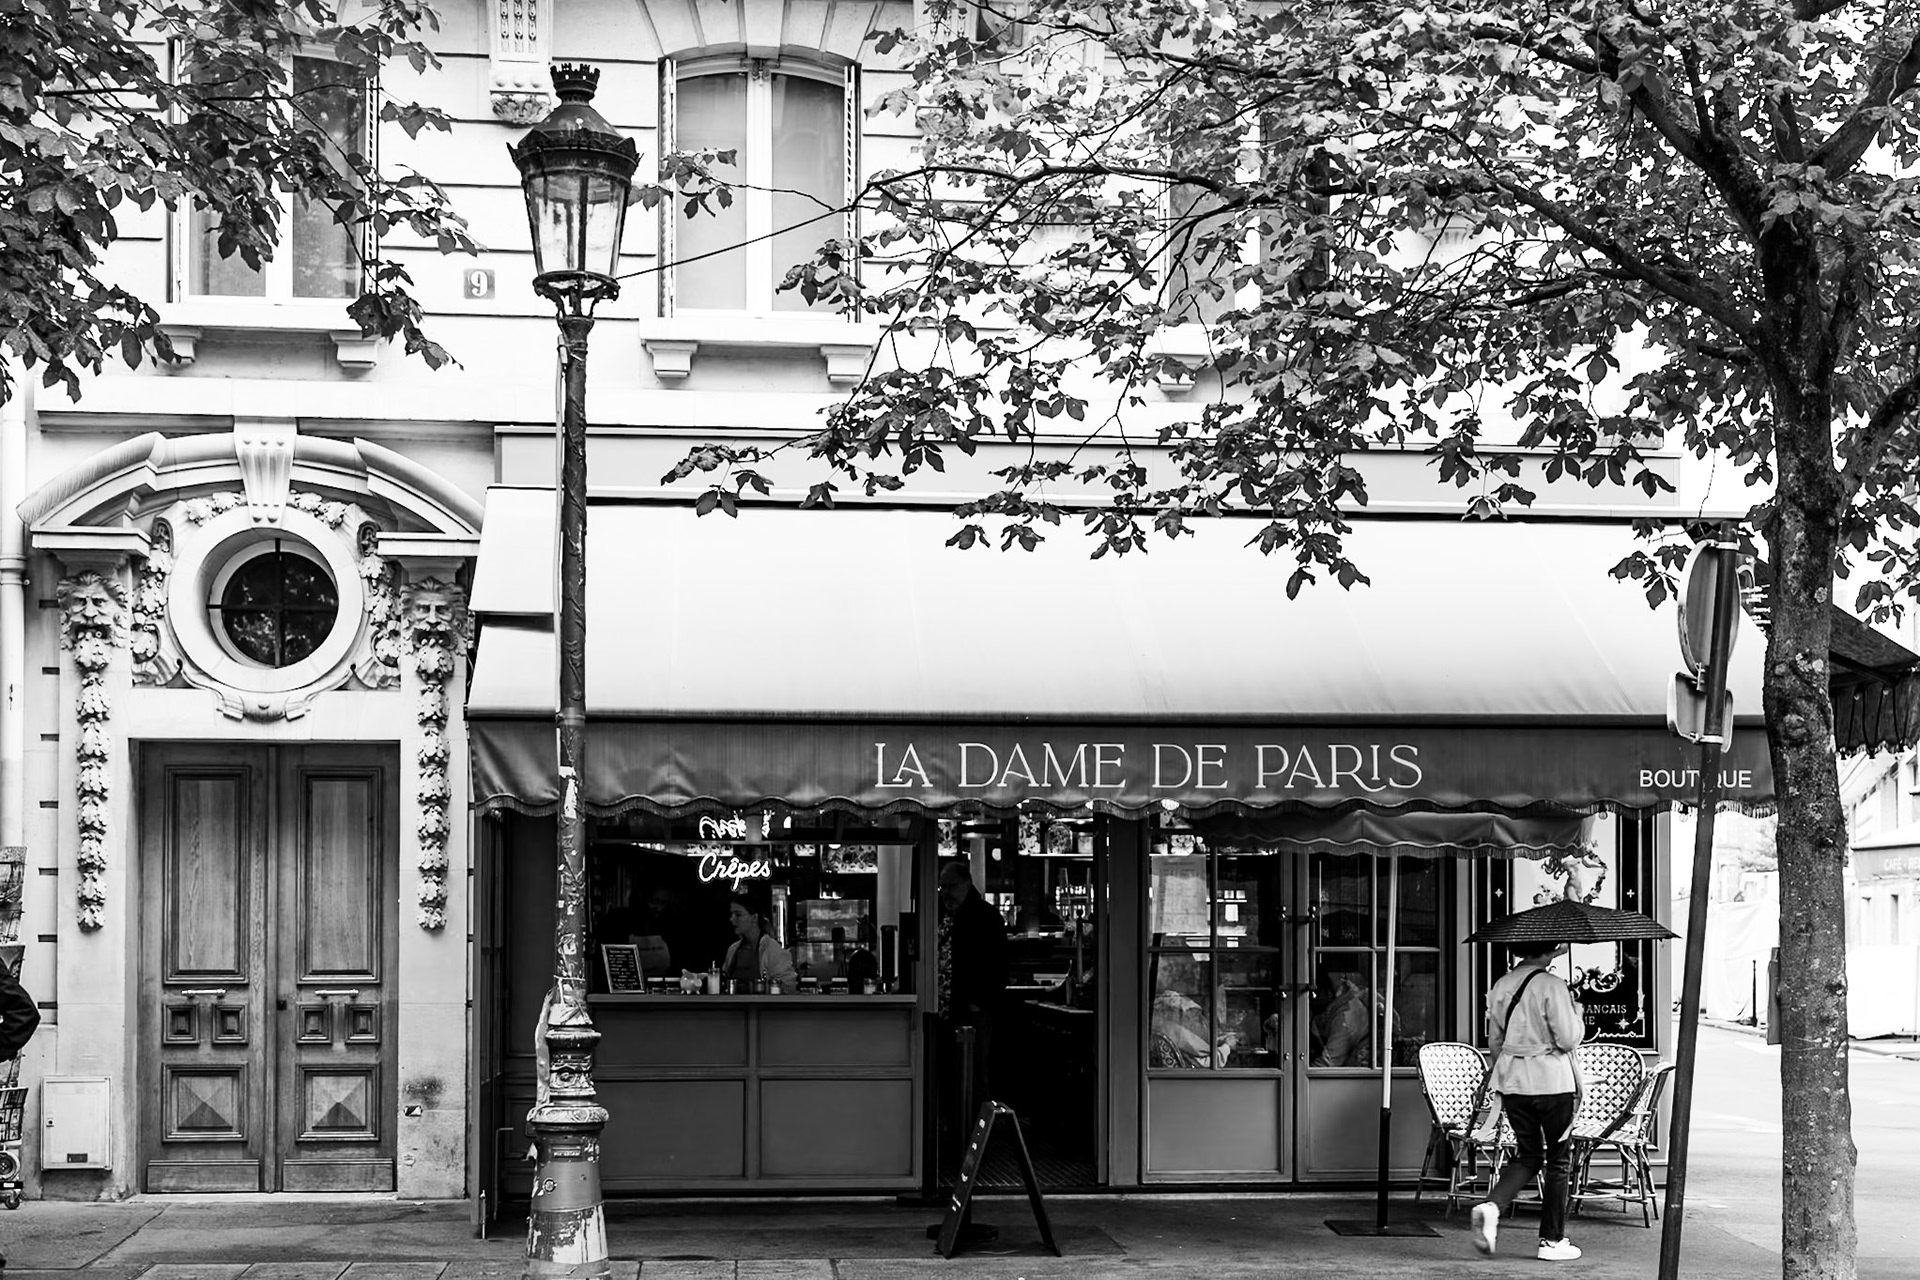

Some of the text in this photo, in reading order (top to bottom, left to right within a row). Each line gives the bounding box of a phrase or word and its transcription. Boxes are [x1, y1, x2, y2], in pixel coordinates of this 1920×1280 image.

[471, 270, 488, 297] 9
[874, 742, 1424, 793] LA DAME DE PARIS
[1639, 768, 1752, 789] BOUTUE
[699, 852, 770, 890] Crêpes
[1583, 1004, 1627, 1014] ANCAIS
